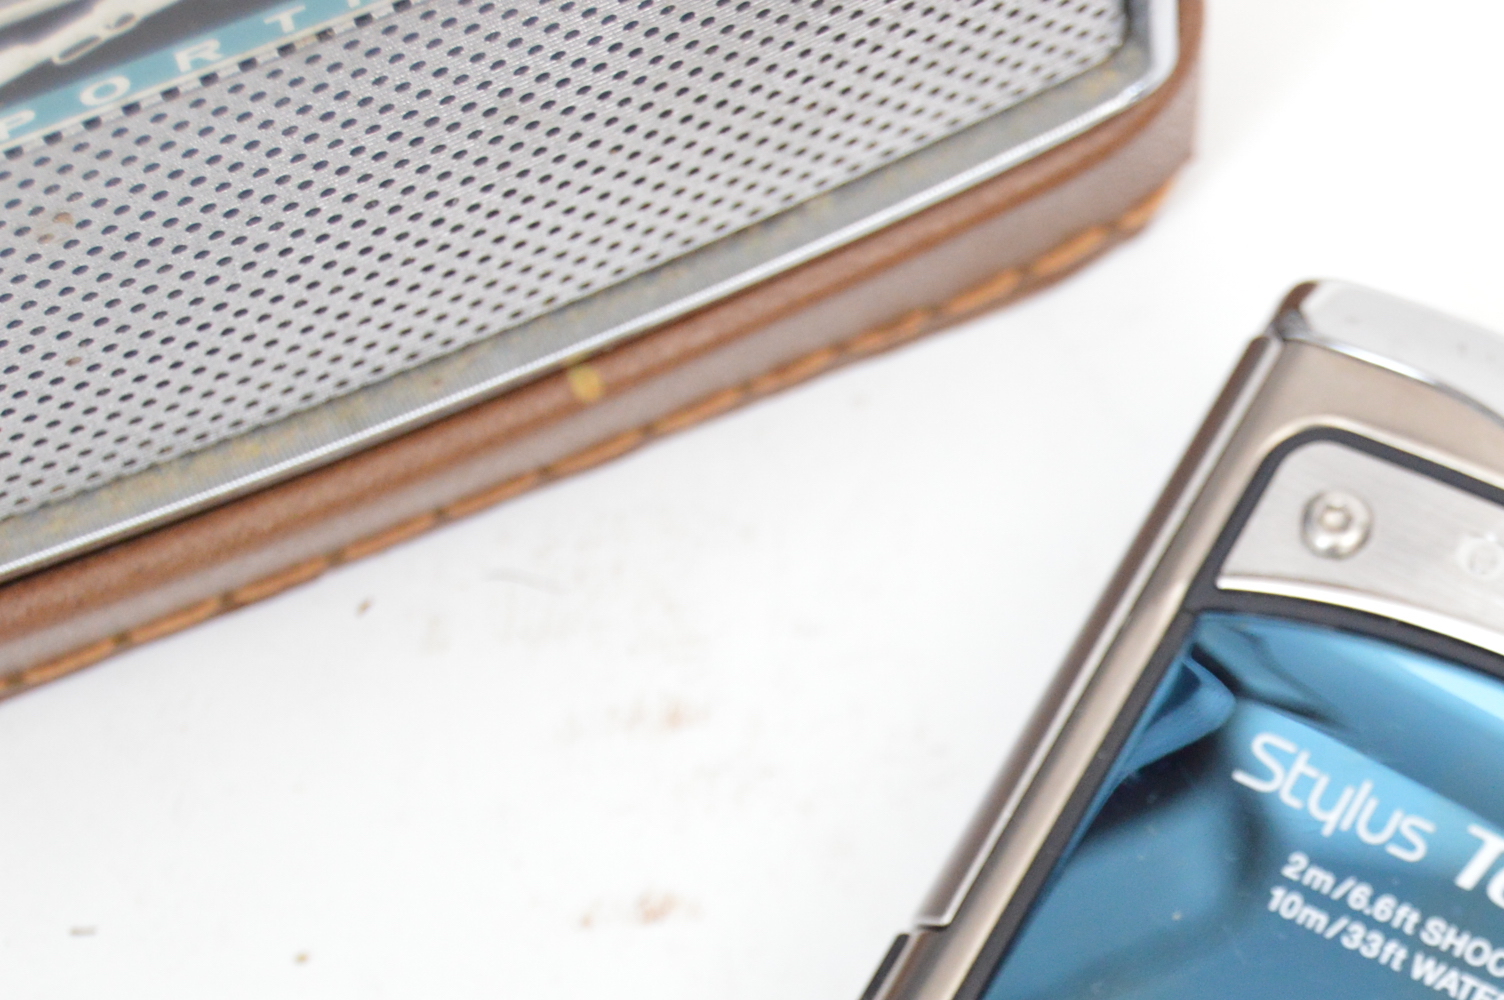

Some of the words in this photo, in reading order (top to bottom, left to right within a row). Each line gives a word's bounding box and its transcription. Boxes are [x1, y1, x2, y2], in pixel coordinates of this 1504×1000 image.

[0, 0, 363, 141] PORT
[1232, 731, 1436, 863] Stylus
[1267, 884, 1408, 972] 10m/33ft
[1280, 850, 1421, 936] 2m/6.6ft
